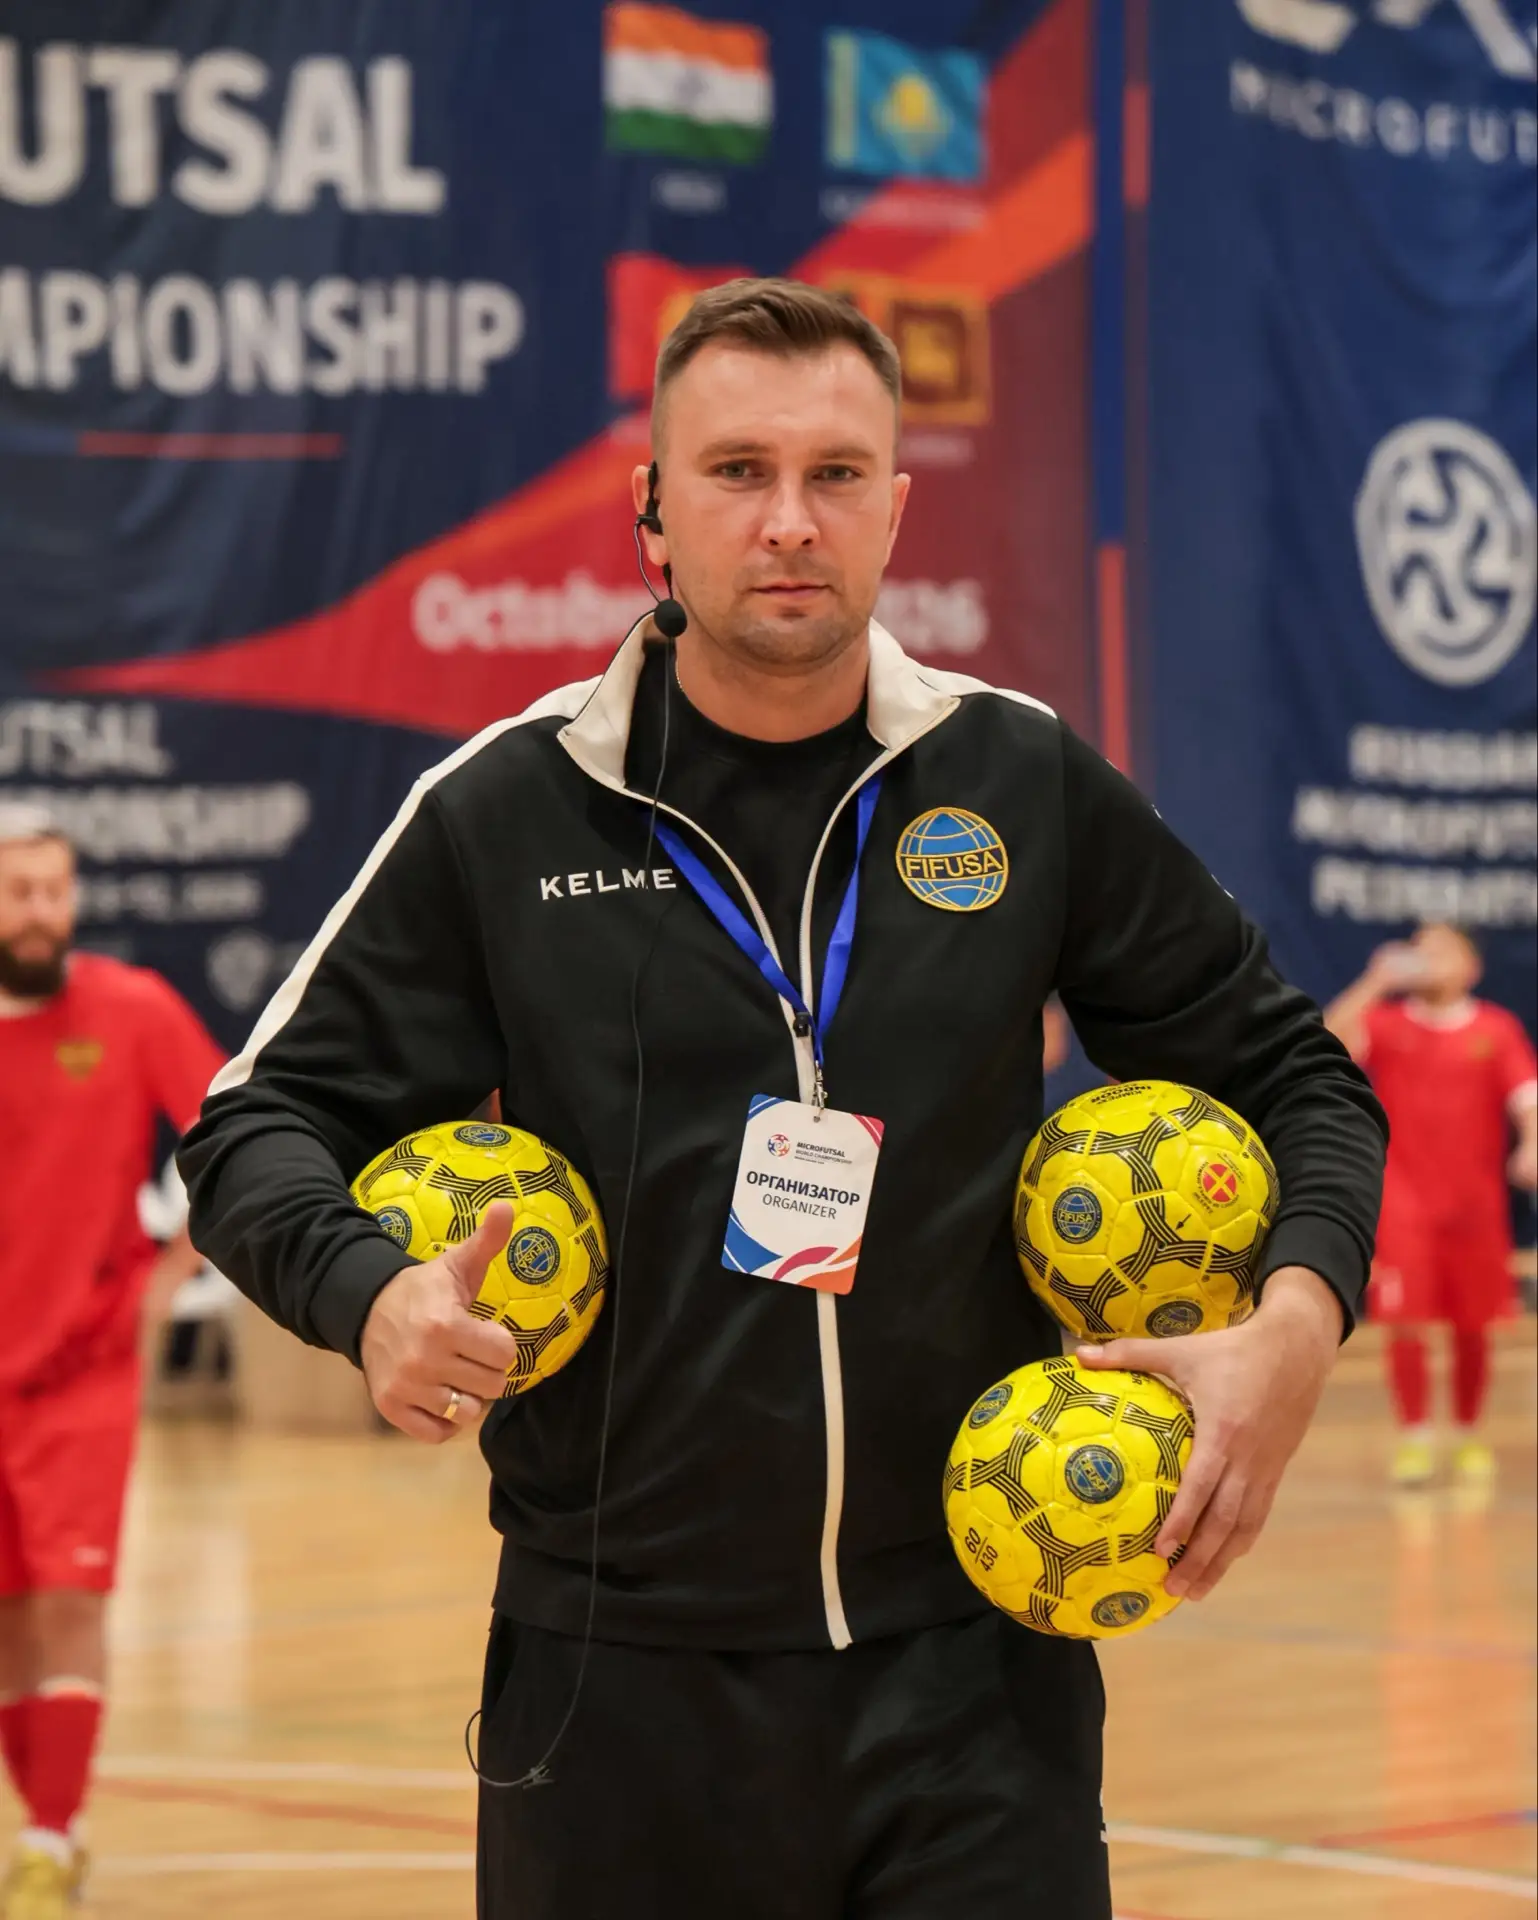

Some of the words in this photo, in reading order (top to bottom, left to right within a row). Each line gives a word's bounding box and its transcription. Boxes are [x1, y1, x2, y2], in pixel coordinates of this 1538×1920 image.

[0, 37, 445, 215] UTSAL
[905, 850, 1003, 878] FIFUSA
[540, 868, 677, 900] KELME
[796, 1141, 846, 1158] MICROFUTSAL
[746, 1171, 860, 1206] ОРГАНИЗАТОР
[762, 1193, 837, 1219] ORGANIZER
[1060, 1211, 1092, 1223] FIFUSA
[519, 1240, 549, 1267] FIFUSA
[964, 1527, 981, 1554] 60
[979, 1545, 999, 1572] 430
